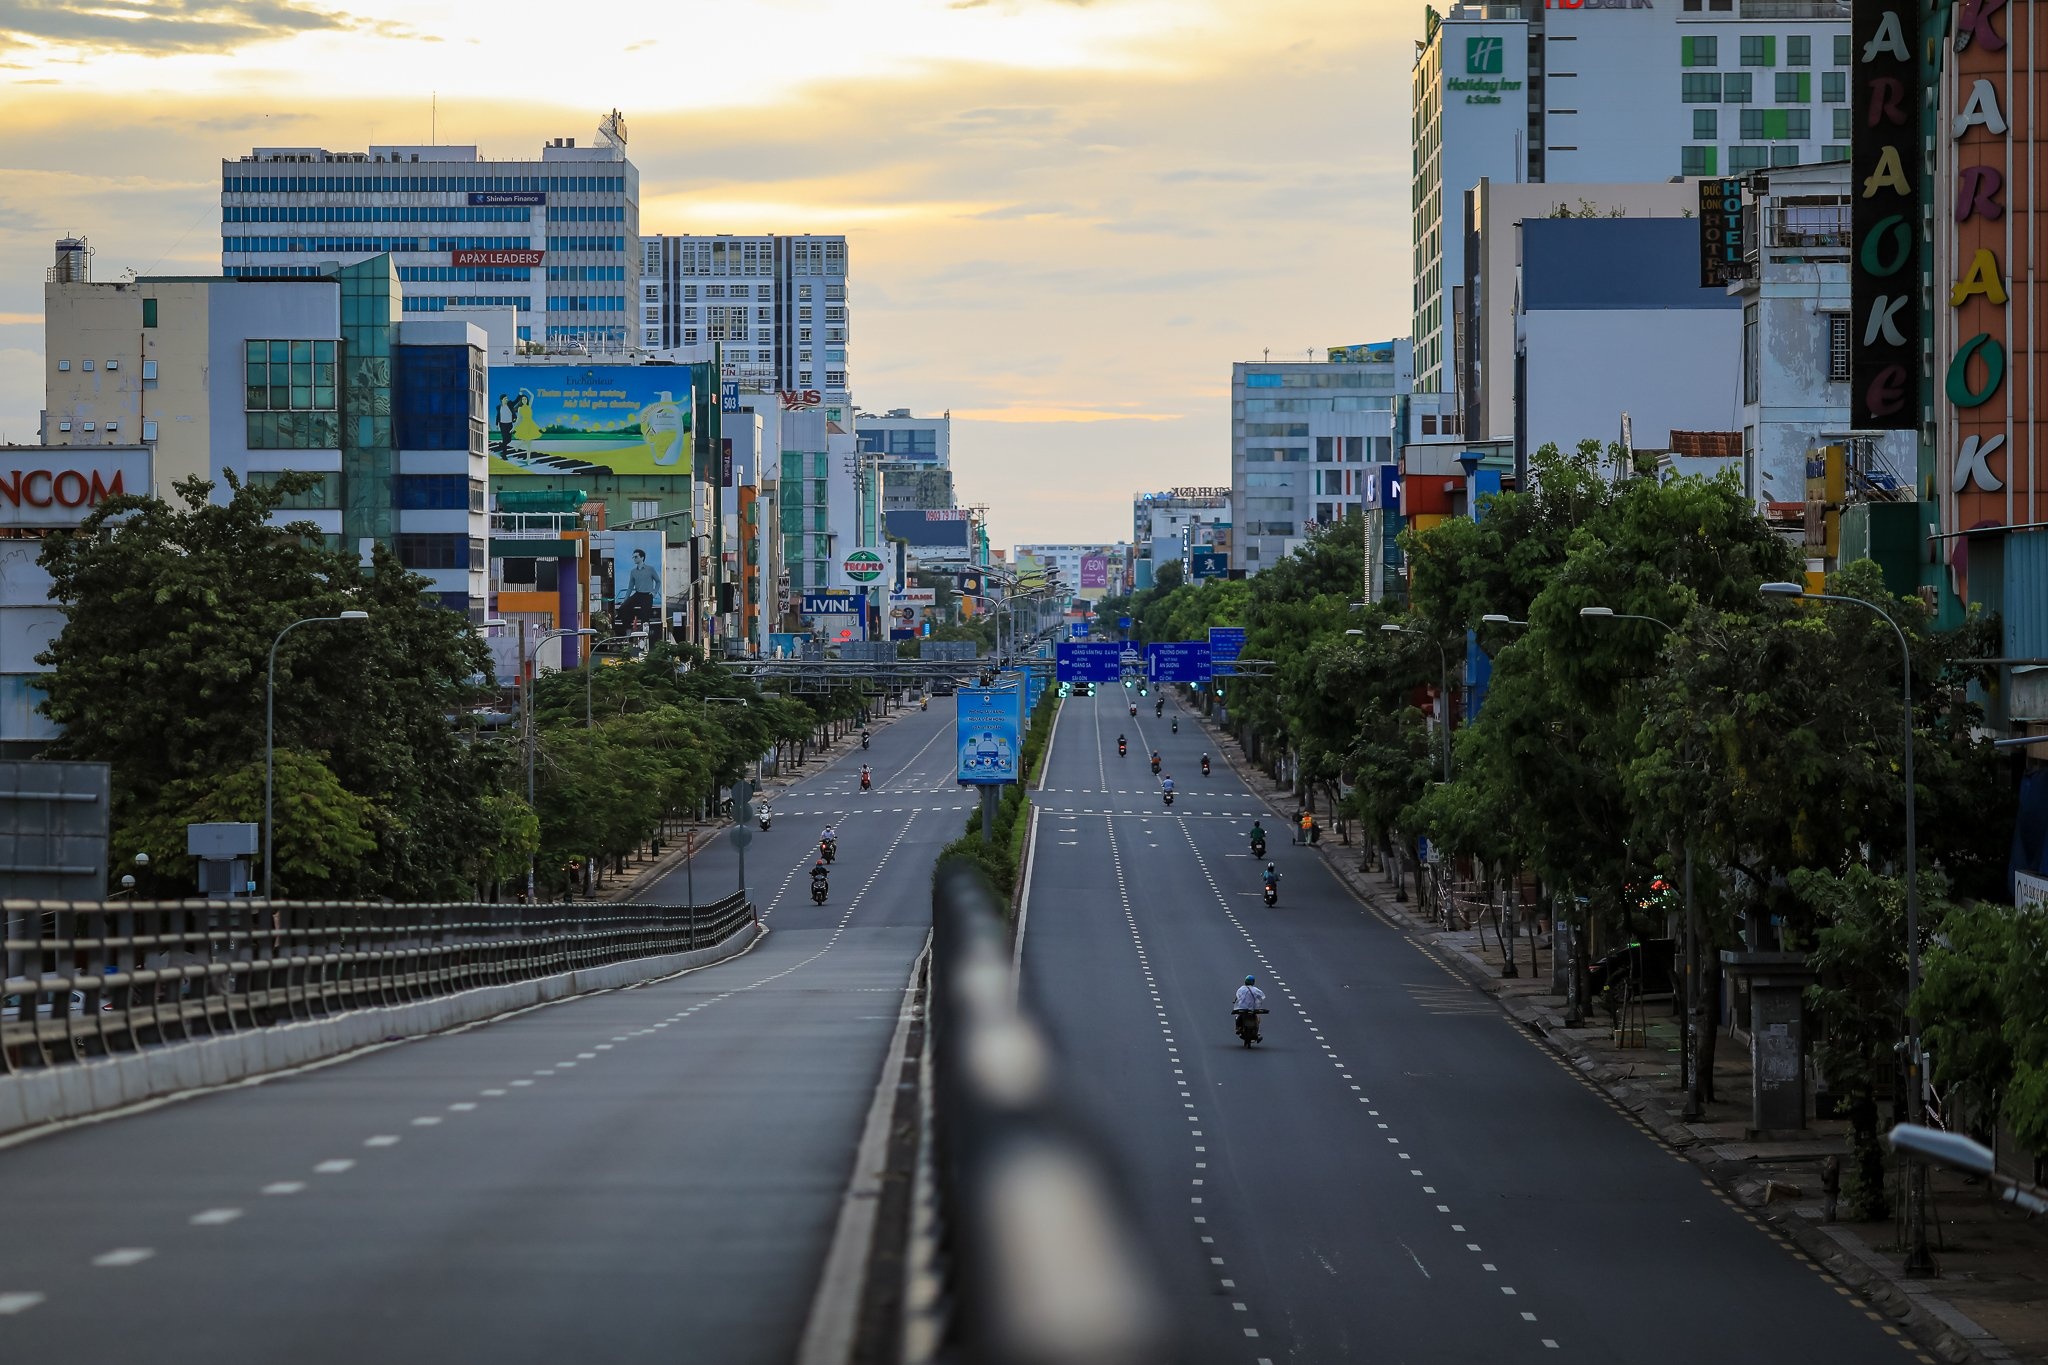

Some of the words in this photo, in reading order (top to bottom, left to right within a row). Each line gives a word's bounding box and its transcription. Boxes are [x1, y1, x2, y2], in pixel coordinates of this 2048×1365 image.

[1447, 77, 1500, 94] Holiday
[1501, 77, 1523, 91] Inn
[1475, 95, 1502, 105] Suites
[486, 195, 513, 203] Shinhan
[513, 195, 539, 203] Finance
[1723, 181, 1742, 262] HOTEL
[459, 253, 487, 264] APAX
[490, 253, 540, 264] LEADERS
[724, 397, 737, 409] 503
[843, 562, 884, 571] TECAPRO
